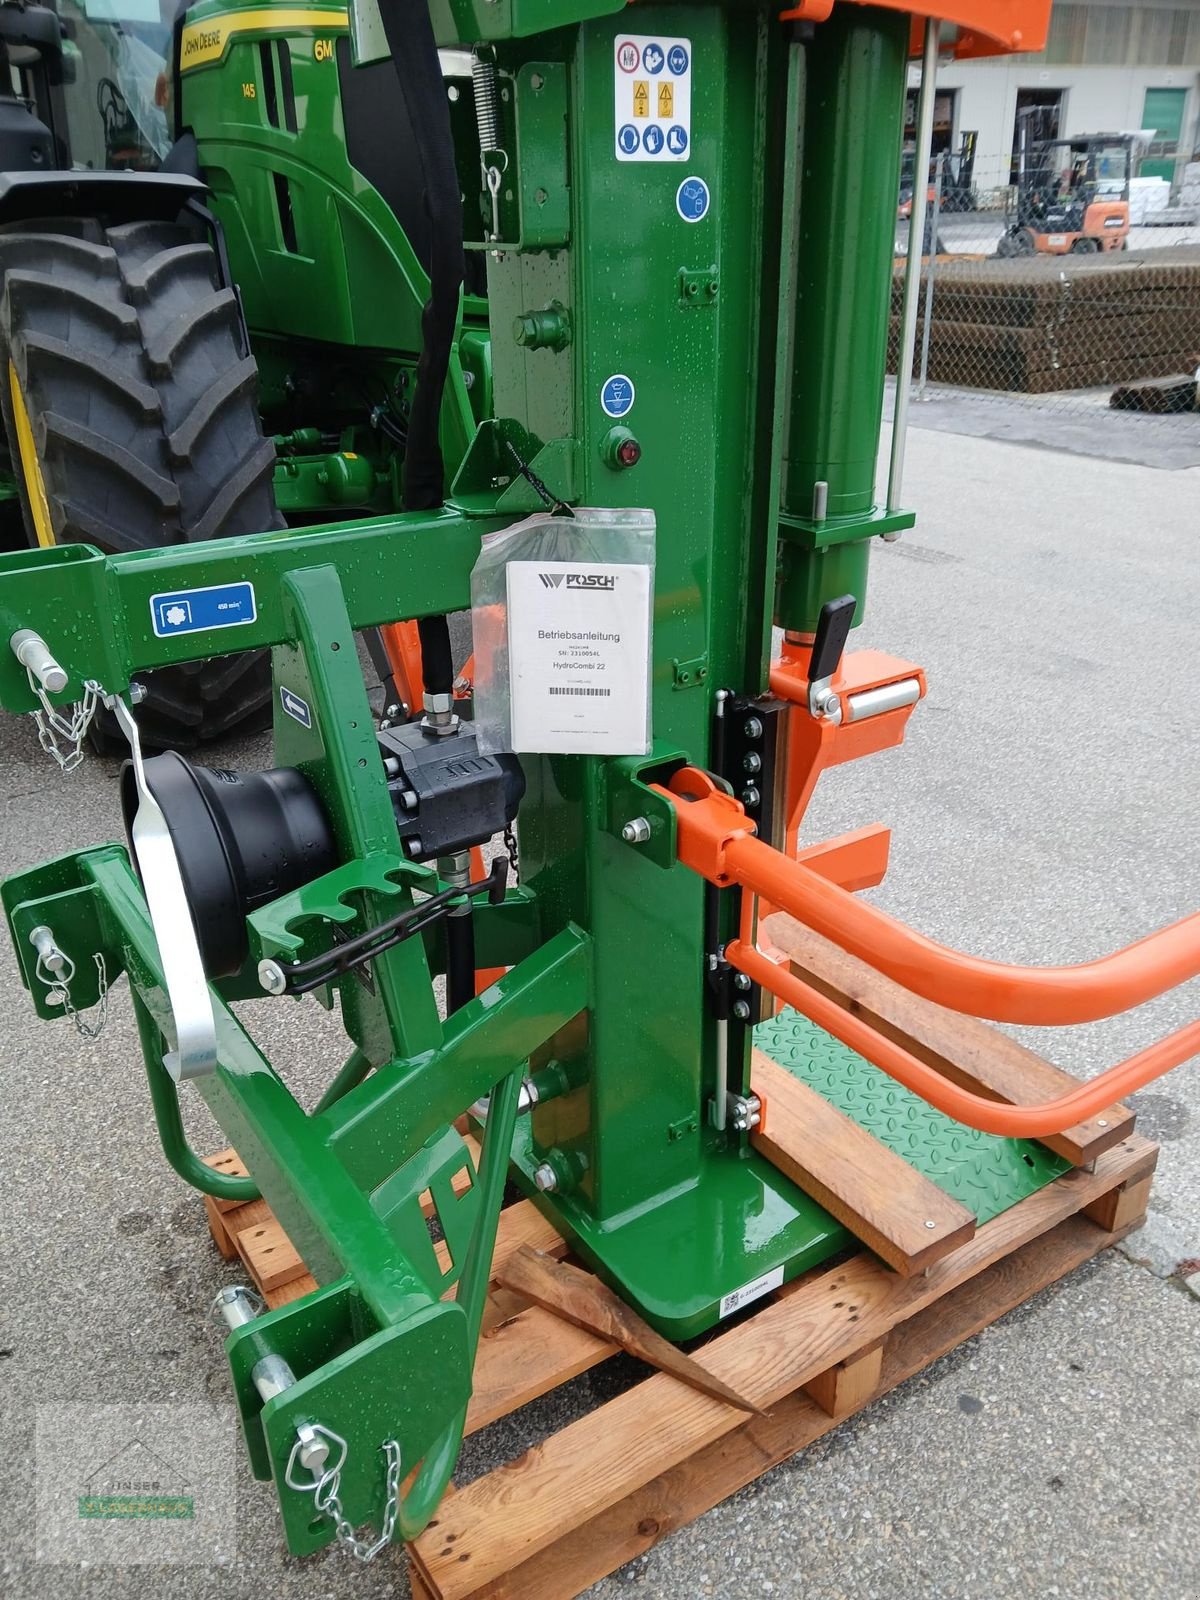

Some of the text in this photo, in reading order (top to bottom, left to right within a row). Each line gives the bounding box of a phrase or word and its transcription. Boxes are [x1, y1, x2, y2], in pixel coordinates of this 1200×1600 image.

[184, 30, 221, 56] JOHN DEERE
[314, 39, 333, 61] 6M
[242, 83, 256, 98] 145
[538, 630, 620, 643] Betriebsanleitung
[553, 662, 595, 670] HydroCombi
